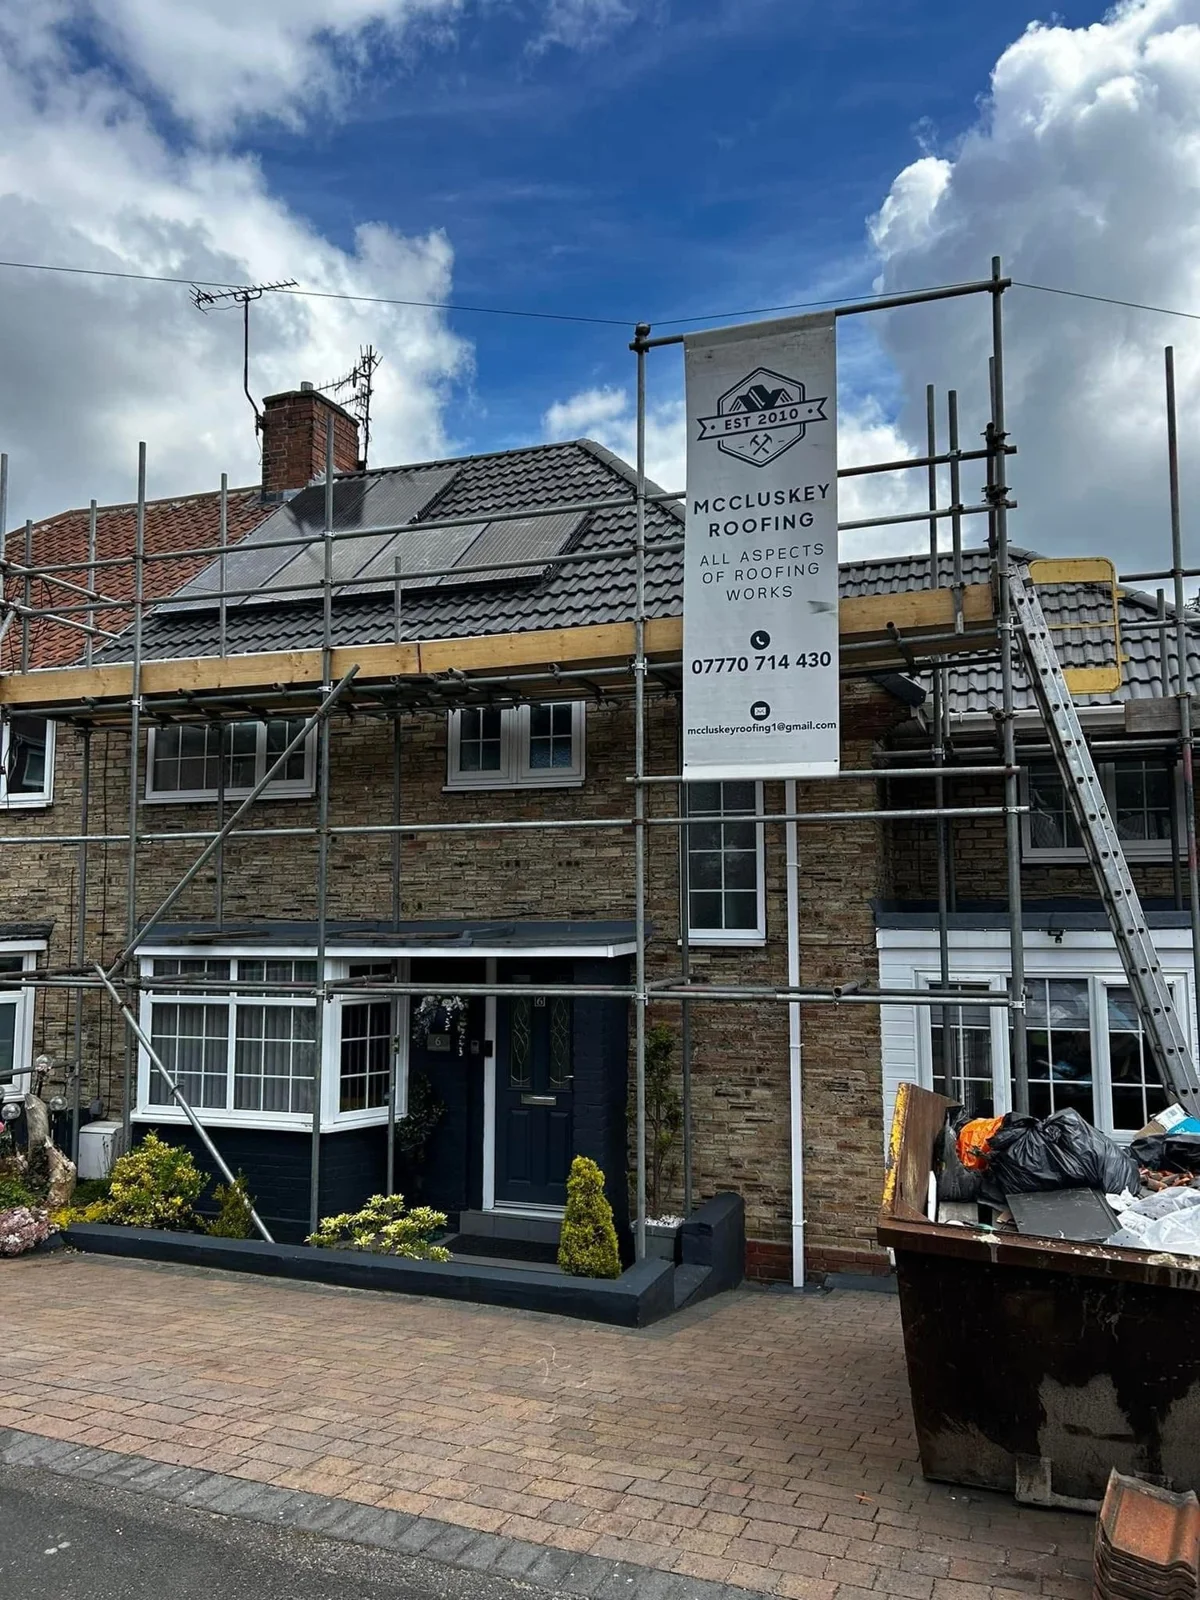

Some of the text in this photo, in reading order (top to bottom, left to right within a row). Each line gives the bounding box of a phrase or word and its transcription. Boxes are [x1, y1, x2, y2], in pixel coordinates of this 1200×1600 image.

[724, 408, 799, 430] EST 2010
[694, 483, 830, 515] MCCLUSKEY
[709, 512, 814, 537] ROOFING
[700, 543, 824, 567] ALL ASPECTS
[702, 562, 820, 584] OF ROOFING
[726, 585, 793, 601] WORKS
[692, 651, 831, 674] 07770 714 430
[687, 721, 837, 735] mccluskeyroofing1@gmail.com
[434, 1036, 441, 1046] 6
